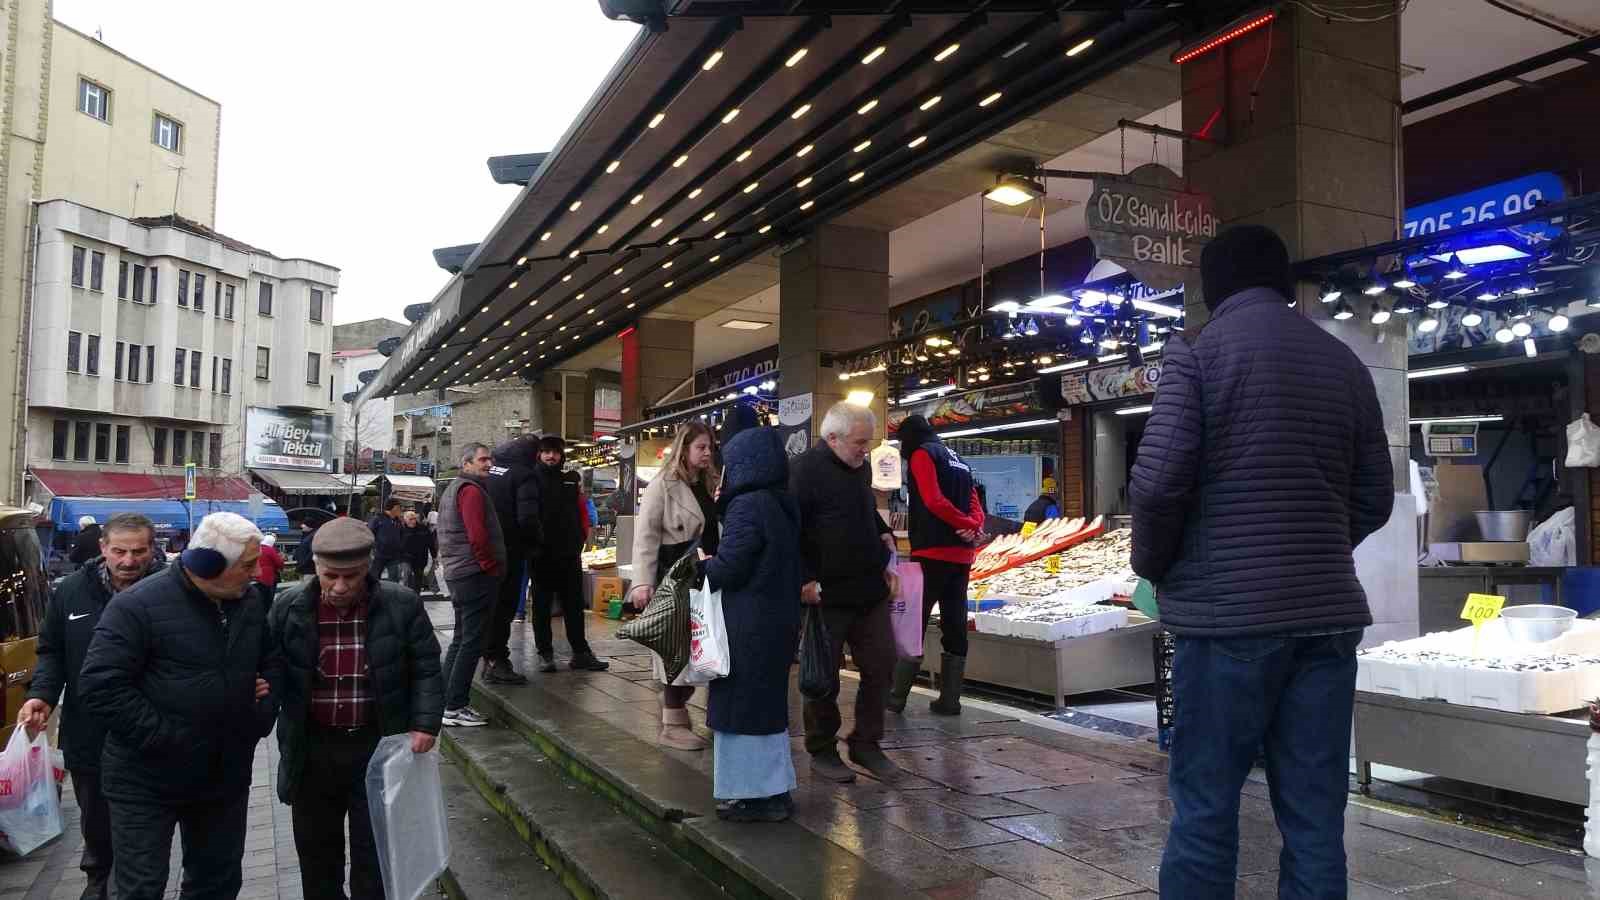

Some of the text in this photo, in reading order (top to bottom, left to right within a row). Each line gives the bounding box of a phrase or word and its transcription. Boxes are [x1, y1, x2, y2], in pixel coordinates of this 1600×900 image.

[1098, 188, 1221, 238] ÖZ Sandıkçılar
[1132, 235, 1193, 265] Balık
[284, 425, 310, 440] Bey
[282, 440, 322, 457] Tekstil
